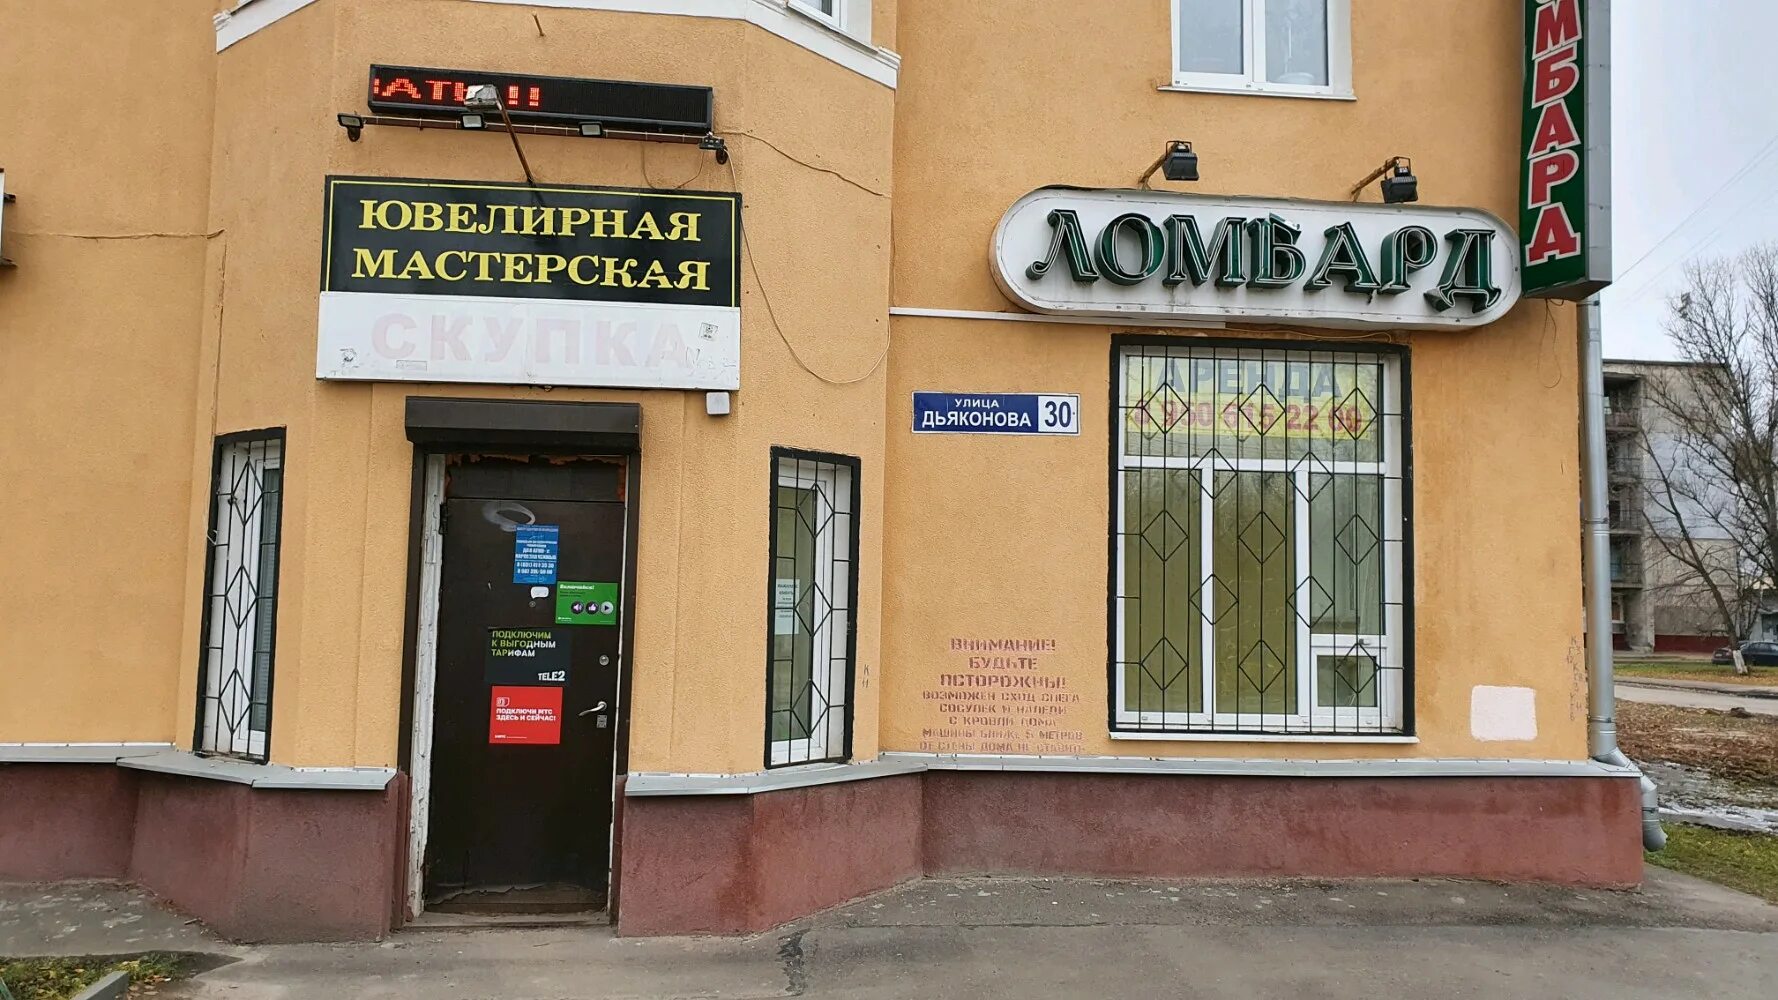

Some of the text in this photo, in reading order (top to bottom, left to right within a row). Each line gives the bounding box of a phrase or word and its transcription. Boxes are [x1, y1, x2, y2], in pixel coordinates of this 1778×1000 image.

[1525, 0, 1583, 265] МБАРД
[358, 198, 702, 242] ЮВЕЛИРНАЯ
[1025, 208, 1501, 313] ЛОМБАРД
[350, 248, 711, 292] МАСТЕРСКАЯ
[371, 311, 689, 368] СКУПКА
[1156, 362, 1342, 402] АРЕНДА
[954, 398, 1000, 408] УЛИЦА
[921, 401, 1072, 428] ДЬЯКОНОВА 30
[1287, 404, 1319, 431] 22
[492, 630, 552, 639] ПОДКЛЮЧИМ
[491, 639, 556, 649] К ВЫГОДНЫМ
[950, 638, 1056, 651] ВНИМАНИЕ!
[491, 648, 536, 657] ТАРИФАМ
[968, 656, 1038, 670] БУДЬТЕ
[537, 670, 566, 682] TELE2
[922, 690, 1080, 703] ВОЗМОЖЕН СХОД СНЕГА
[939, 703, 997, 713] СОСУЛЕК
[526, 714, 556, 722] СЕЙЧАС!
[949, 716, 957, 725] С
[963, 716, 1014, 727] КРОВЛИ
[1039, 730, 1083, 741] МЕТРОВ
[980, 742, 1013, 752] ДОМА
